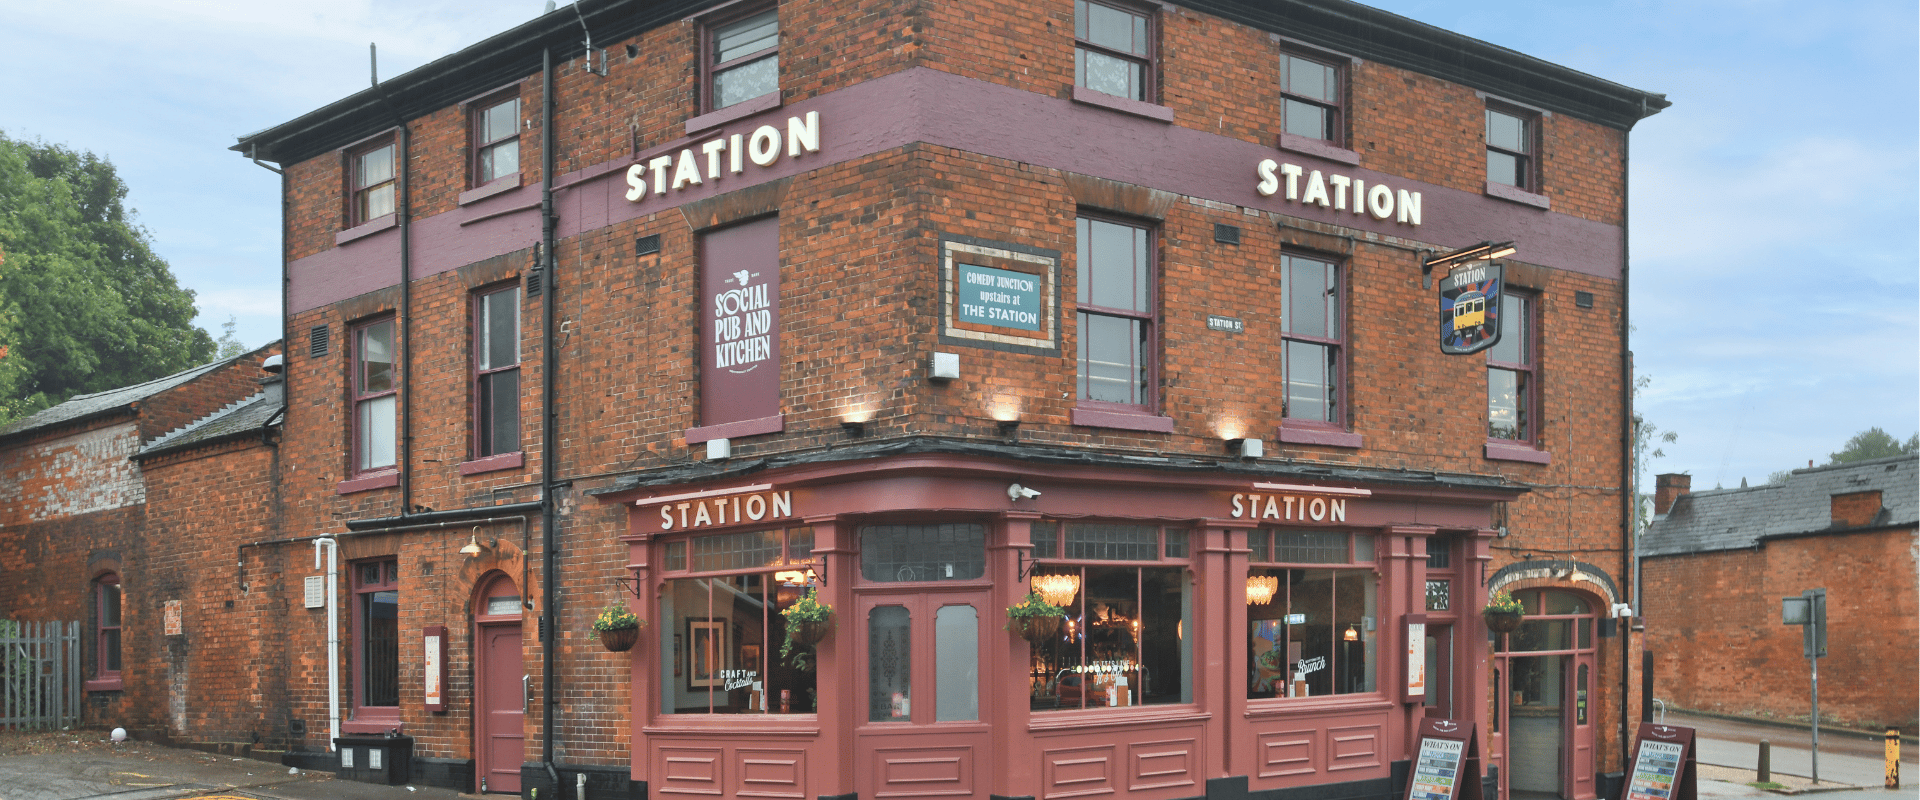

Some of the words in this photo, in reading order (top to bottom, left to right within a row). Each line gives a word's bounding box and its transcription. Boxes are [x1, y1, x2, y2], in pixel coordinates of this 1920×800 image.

[625, 111, 819, 203] STATION
[1257, 159, 1422, 226] STATION
[966, 271, 995, 287] COMEDY
[997, 276, 1034, 293] JUNCTION
[1454, 266, 1486, 287] STATION
[715, 283, 770, 317] SOCIAL
[980, 290, 1011, 304] upstairs
[1012, 294, 1021, 306] at
[962, 303, 985, 318] THE
[988, 306, 1037, 325] STATION
[1209, 317, 1233, 329] STATION
[715, 315, 741, 343] PUB
[744, 309, 771, 338] AND
[716, 334, 770, 368] KITCHEN
[661, 490, 792, 530] STATION
[1231, 493, 1346, 522] STATION
[720, 669, 746, 679] CRAFT
[1297, 655, 1326, 675] Brunch
[724, 676, 754, 692] Cocktails
[1423, 740, 1449, 749] WHAT'S
[1449, 743, 1462, 751] ON
[1643, 742, 1669, 751] WHAT'S
